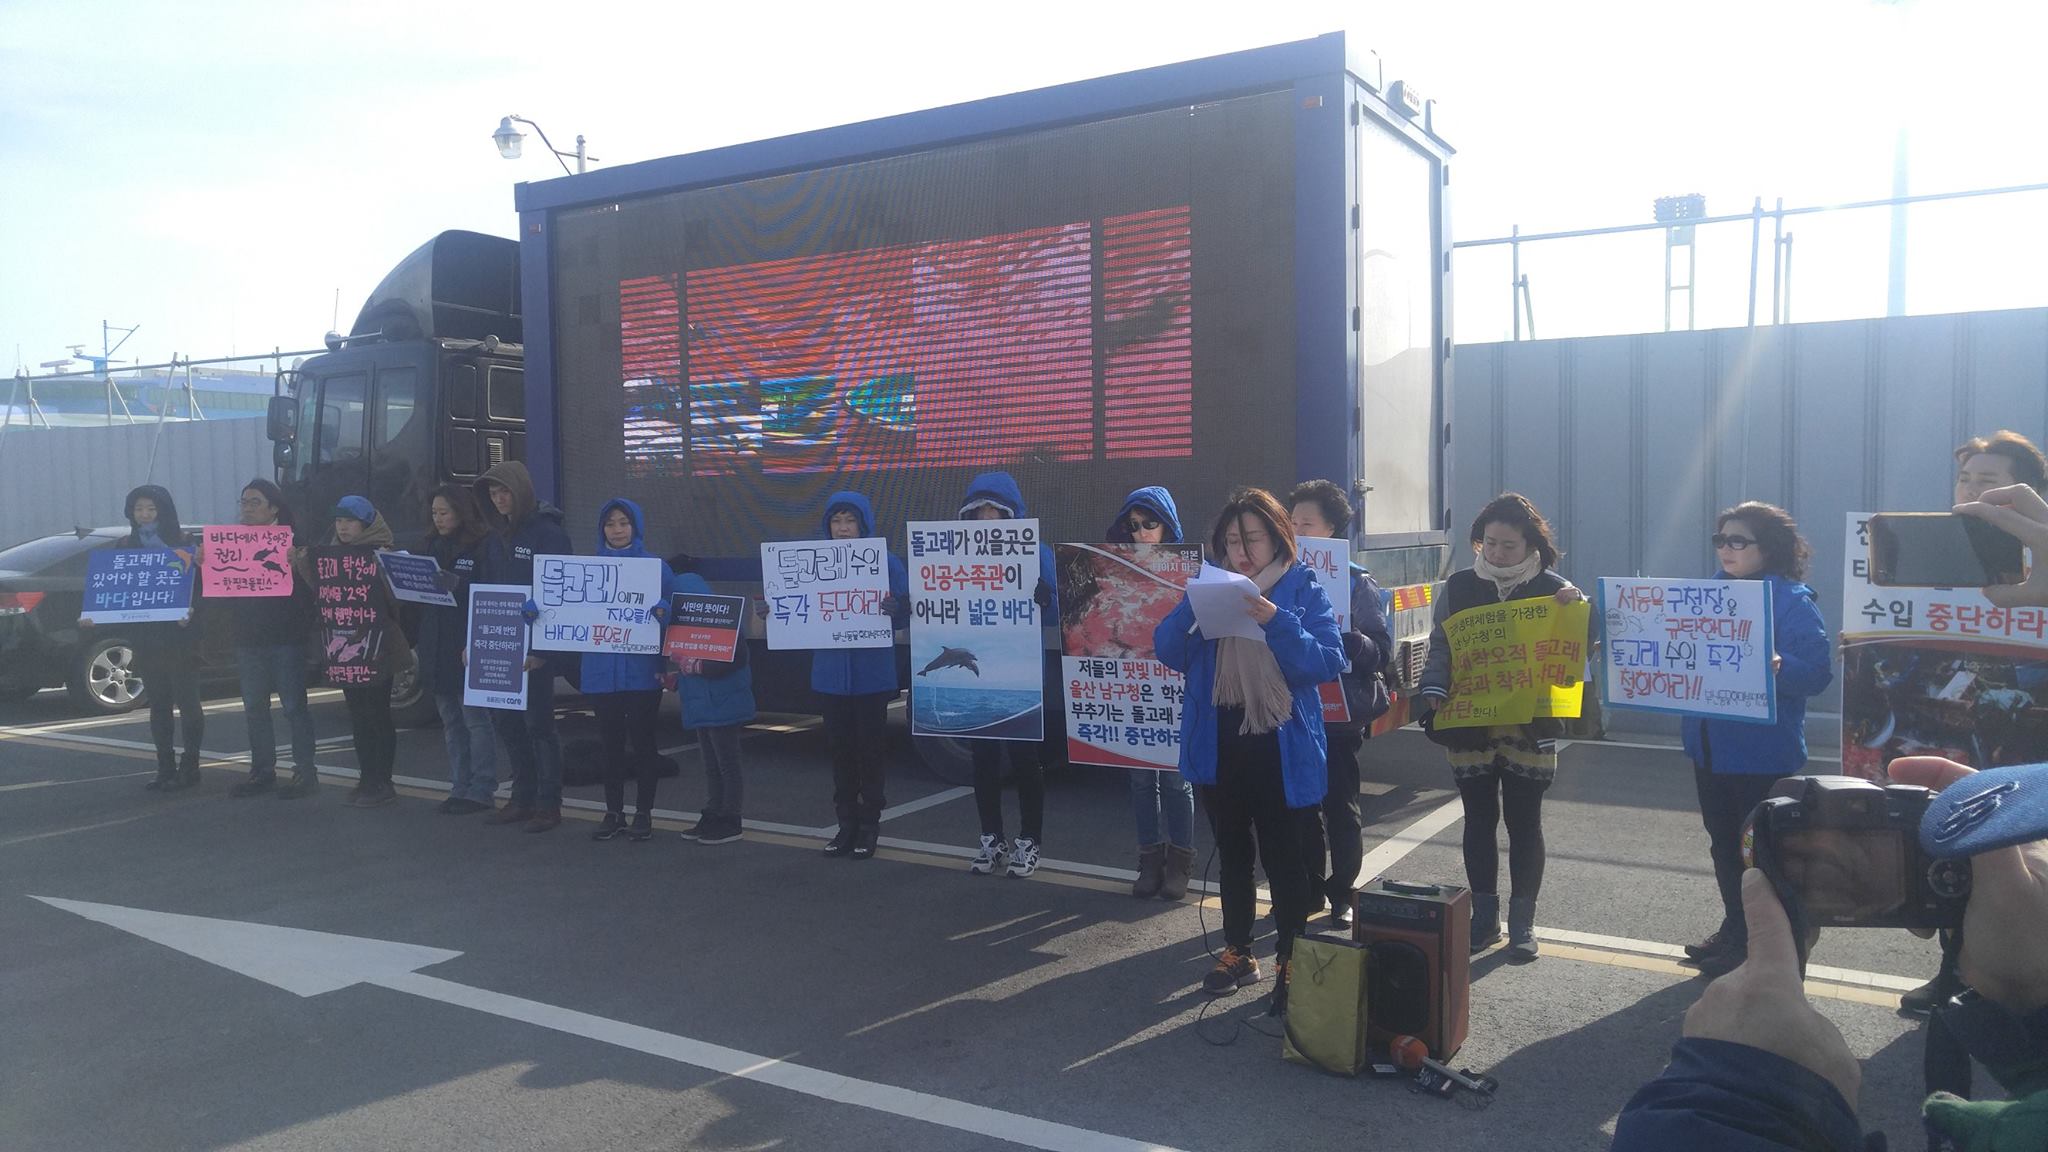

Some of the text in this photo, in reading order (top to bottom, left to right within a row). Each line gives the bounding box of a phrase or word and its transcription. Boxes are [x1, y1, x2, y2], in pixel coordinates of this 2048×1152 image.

[210, 532, 259, 544] 바다에서
[911, 529, 970, 557] 돌고래가
[113, 553, 167, 569] 돌고래가
[1180, 550, 1199, 560] 일본
[92, 570, 182, 588] 있어야 할 곳은
[343, 556, 377, 580] 학살에
[921, 563, 1022, 591] 인공수족관이
[95, 590, 175, 608] 바다입니다!
[682, 602, 730, 615] 시민의 뜻이다!
[772, 594, 810, 626] 즉각
[916, 598, 1035, 626] 아니라 넓은 바다
[1512, 605, 1548, 621] 가장한
[1861, 598, 2047, 639] 수입 중단하라
[545, 624, 589, 642] 바다의
[1534, 639, 1581, 663] 돌고래
[1611, 639, 1743, 672] 돌고래 수입 즉각
[1079, 659, 1119, 679] 저들의
[1122, 661, 1150, 681] 핏빛
[1069, 679, 1096, 699] 울산
[1100, 682, 1154, 703] 남구청은
[1620, 668, 1703, 700] 철회하라!!
[1071, 702, 1174, 725] 부추기는 돌고래
[1078, 723, 1119, 743] 즉각!!
